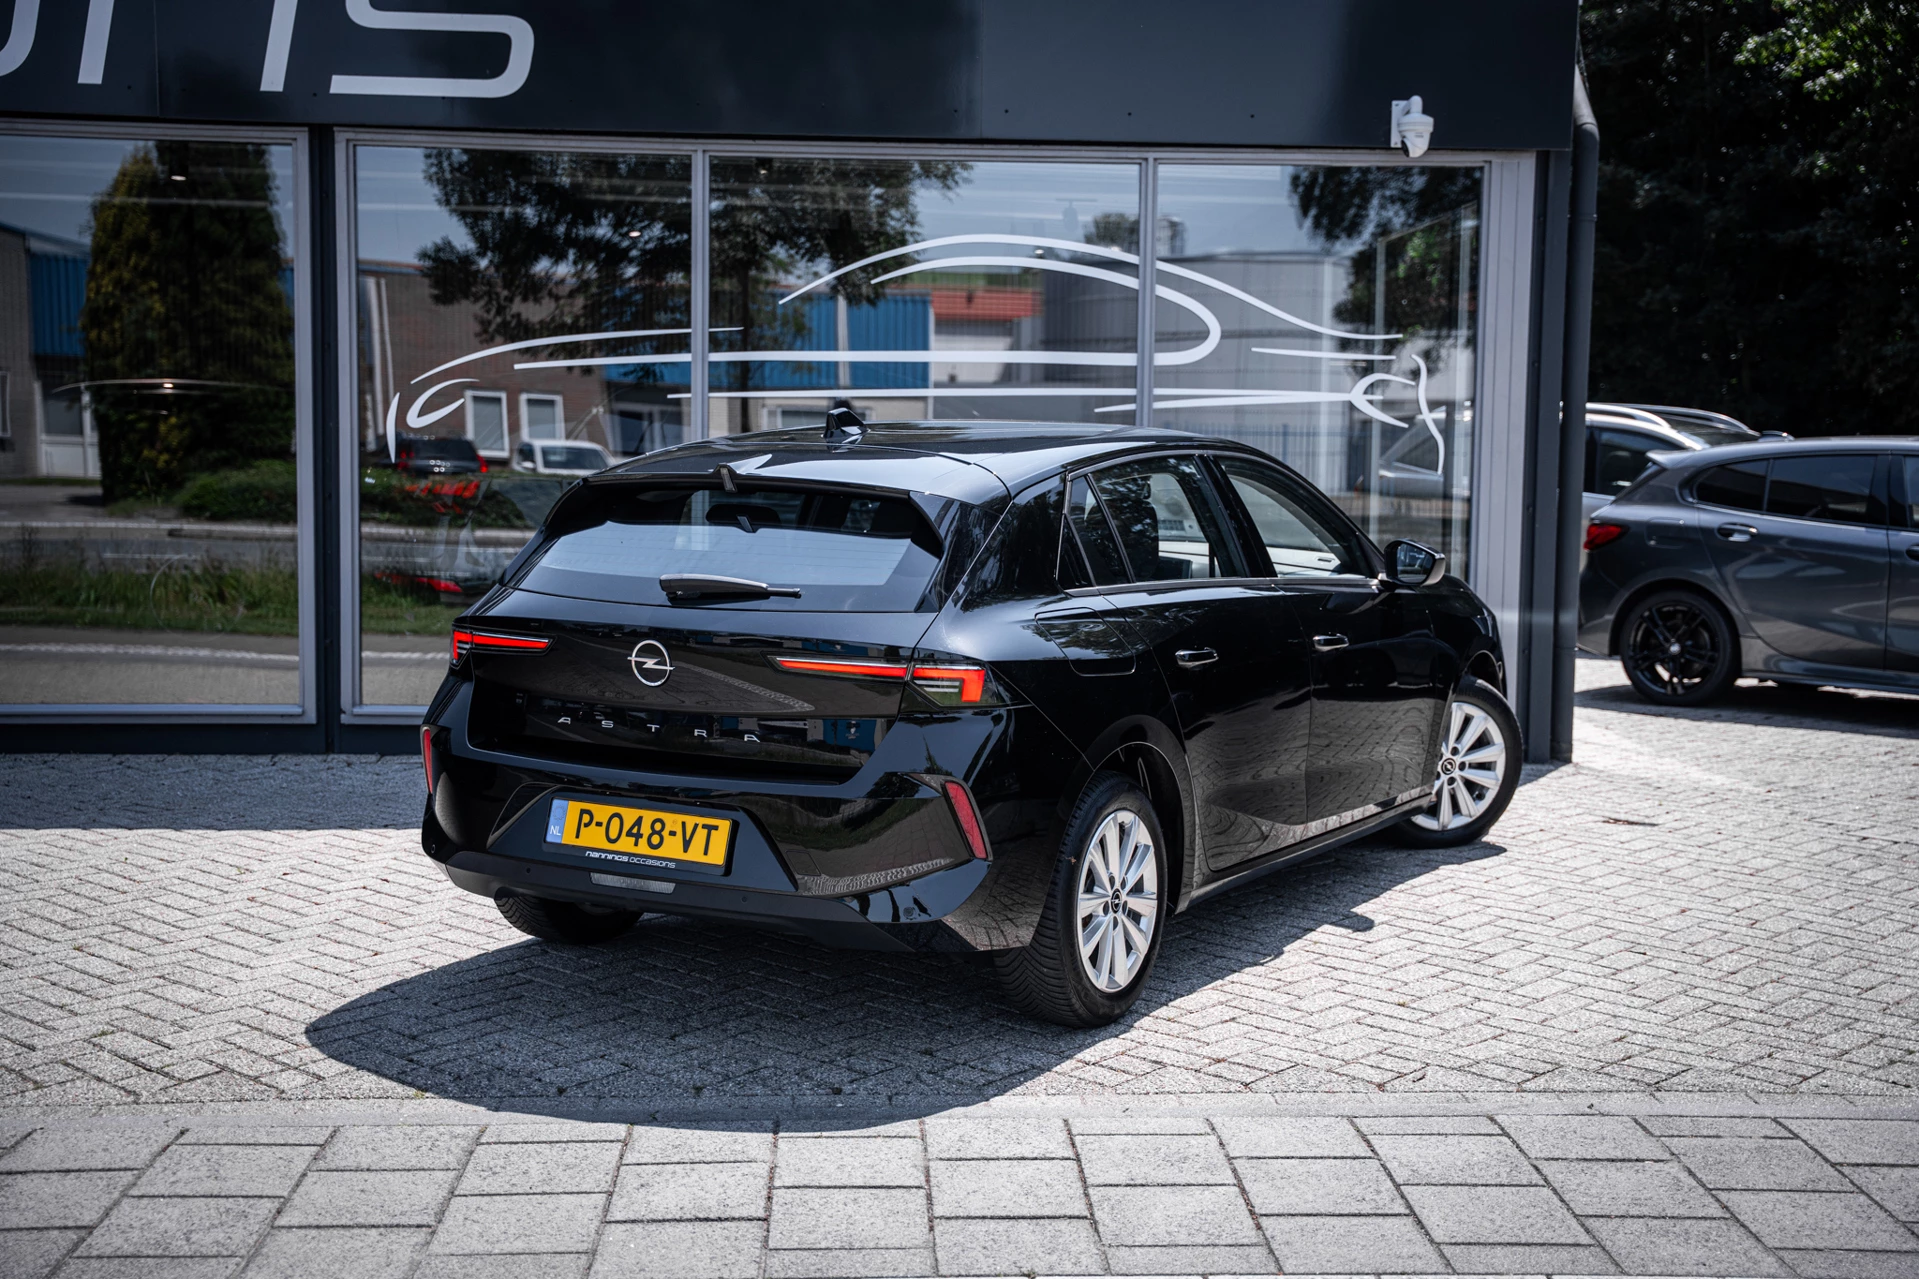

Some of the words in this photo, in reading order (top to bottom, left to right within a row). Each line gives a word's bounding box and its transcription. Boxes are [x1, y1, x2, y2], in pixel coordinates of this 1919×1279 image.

[557, 716, 760, 742] ASTRA
[549, 825, 562, 837] NL
[574, 808, 719, 856] P-048-VT
[629, 856, 676, 868] occasions
